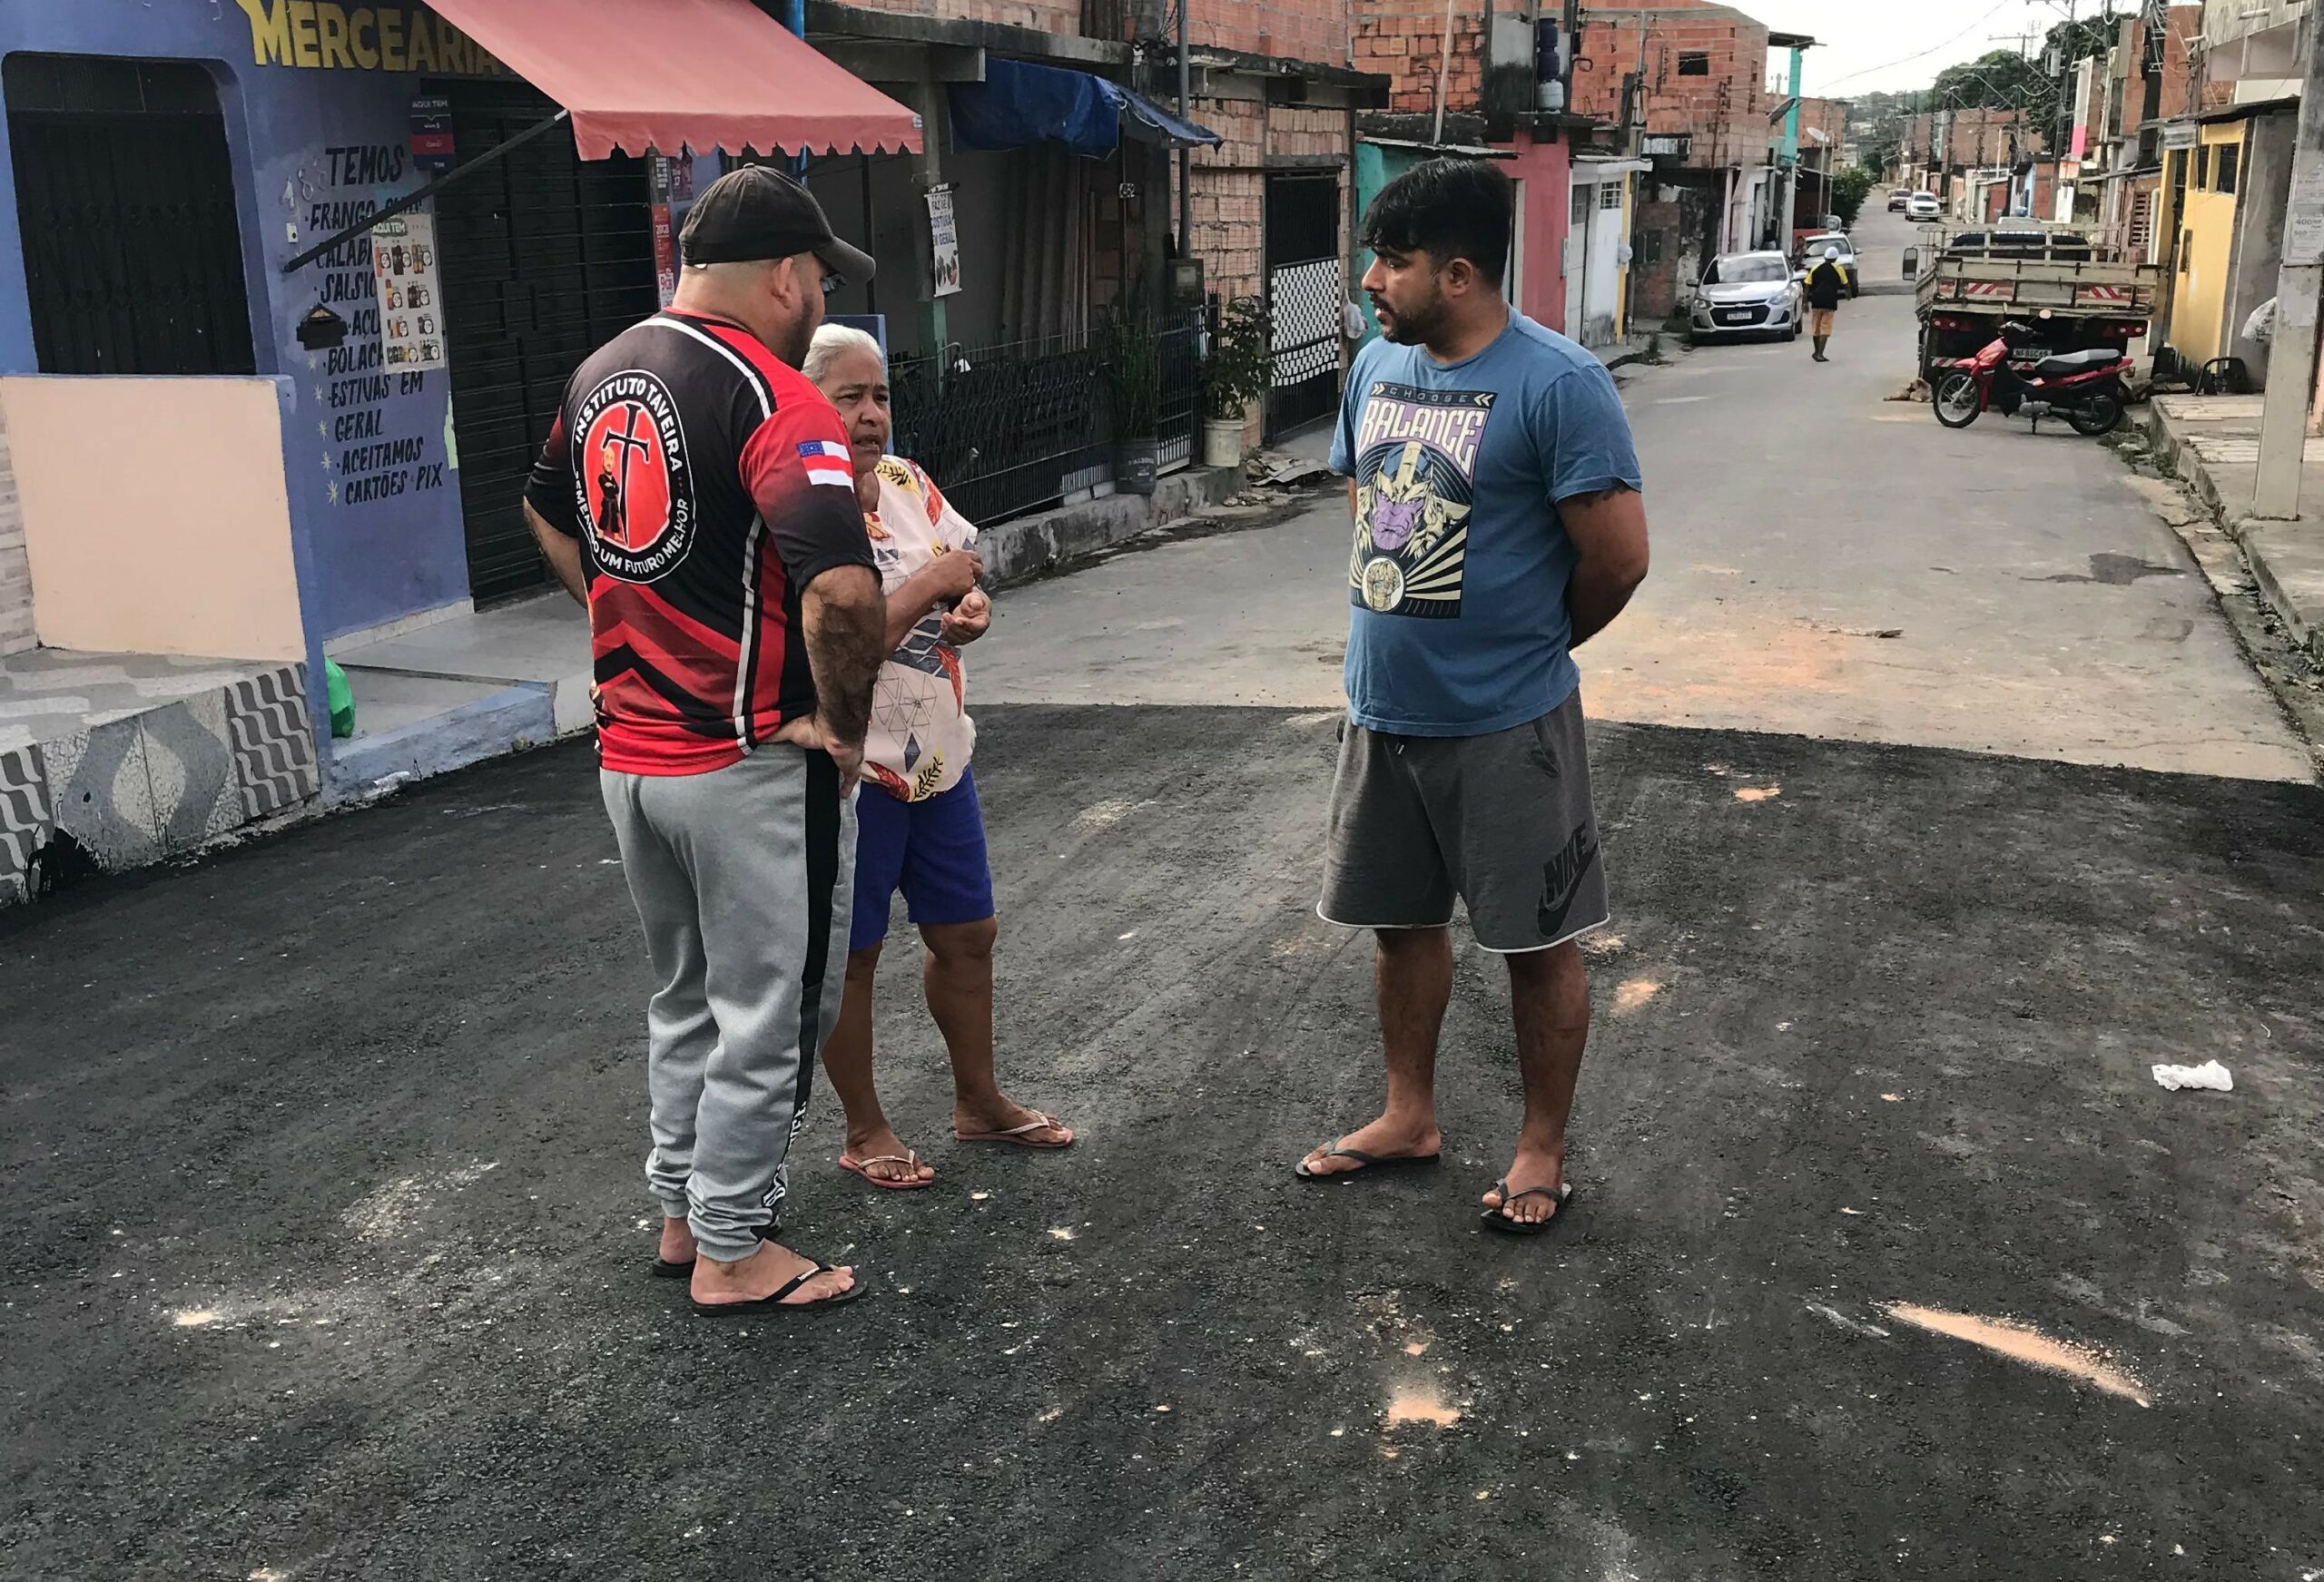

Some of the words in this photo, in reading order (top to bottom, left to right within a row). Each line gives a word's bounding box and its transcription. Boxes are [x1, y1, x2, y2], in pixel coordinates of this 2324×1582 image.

[325, 145, 404, 187] TEMOS
[373, 222, 391, 233] AQUI
[391, 222, 407, 233] TEM
[330, 374, 391, 408] ESTIVAS
[400, 370, 424, 396] EM
[1389, 387, 1468, 402] CHOOSE
[334, 408, 385, 443] GERAL
[575, 378, 645, 445] INSTITUTO
[647, 382, 684, 473] TAVEIRA
[1355, 399, 1486, 477] BALANCE
[341, 436, 424, 476] ACEITAMOS
[345, 469, 409, 506] CARTÕES
[415, 461, 443, 491] PIX
[600, 547, 623, 570] UM
[625, 552, 666, 575] FUTURO
[663, 497, 690, 561] MELHOR
[1543, 820, 1587, 904] NIKE
